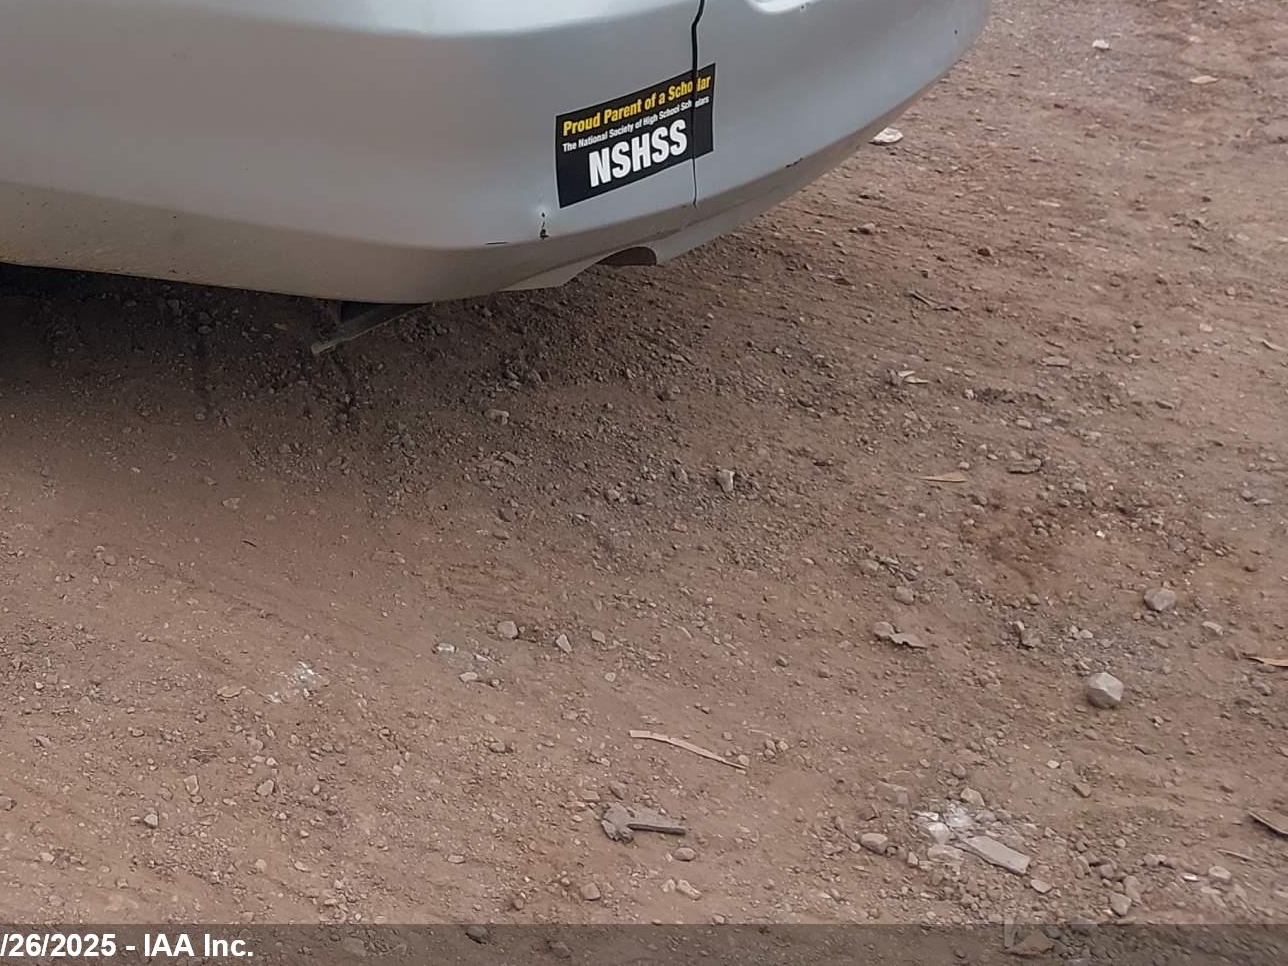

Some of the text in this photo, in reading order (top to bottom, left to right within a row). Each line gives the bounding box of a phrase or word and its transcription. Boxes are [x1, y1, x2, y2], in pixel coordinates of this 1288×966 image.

[562, 142, 577, 153] The
[578, 130, 609, 148] National
[608, 123, 634, 138] Society
[635, 118, 643, 130] of
[643, 113, 658, 126] High
[659, 104, 681, 120] School
[563, 111, 601, 136] Proud
[604, 99, 643, 125] Parent
[644, 92, 657, 111] of
[658, 92, 667, 106] a
[588, 118, 688, 188] NSHSS
